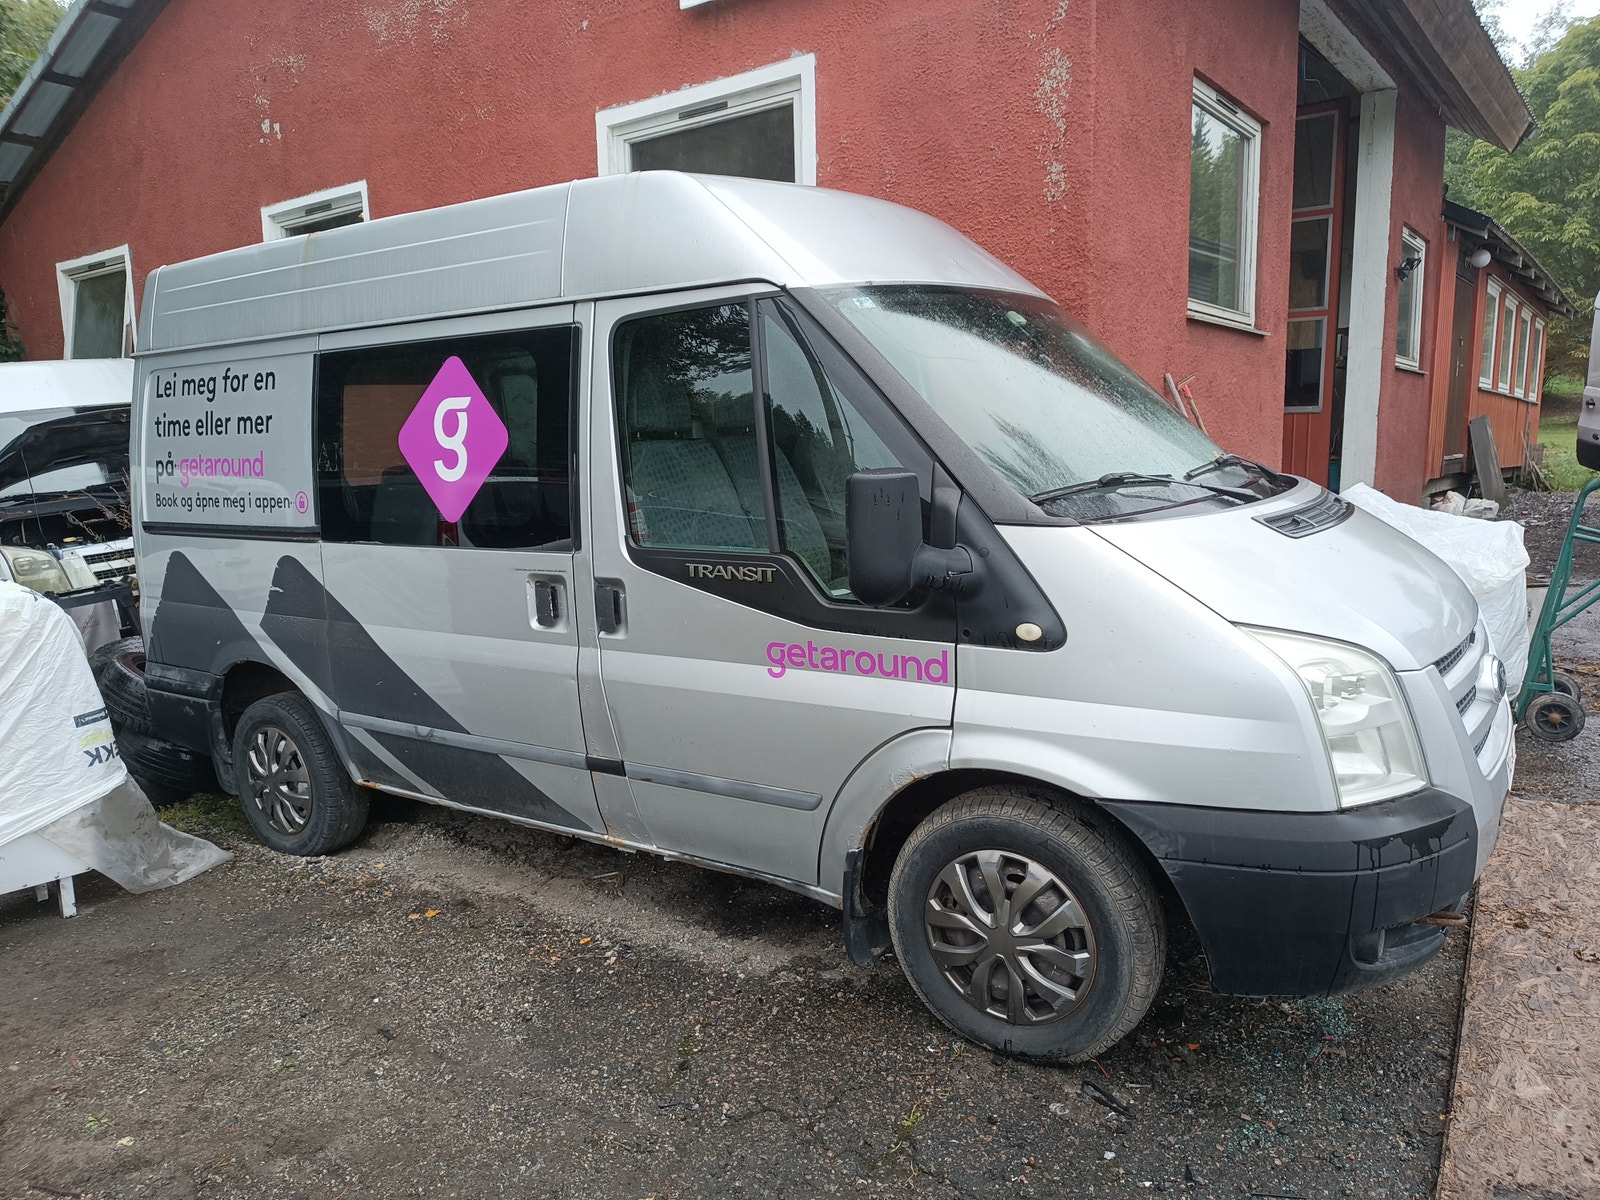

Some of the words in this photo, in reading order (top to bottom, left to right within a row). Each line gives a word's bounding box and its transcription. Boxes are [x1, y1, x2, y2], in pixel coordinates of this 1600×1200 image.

[156, 372, 177, 398] Lei
[181, 376, 217, 403] meg
[222, 367, 249, 393] for
[254, 371, 276, 391] en
[154, 412, 191, 438] time
[195, 410, 231, 436] eller
[237, 414, 273, 435] mer
[155, 451, 175, 485] på
[179, 450, 265, 489] getaround
[155, 493, 179, 508] Book
[181, 496, 193, 512] og
[195, 492, 220, 513] åpne
[222, 496, 246, 513] meg
[248, 492, 252, 508] i
[254, 496, 291, 514] appen
[685, 562, 777, 584] TRANSIT
[766, 640, 949, 684] getaround
